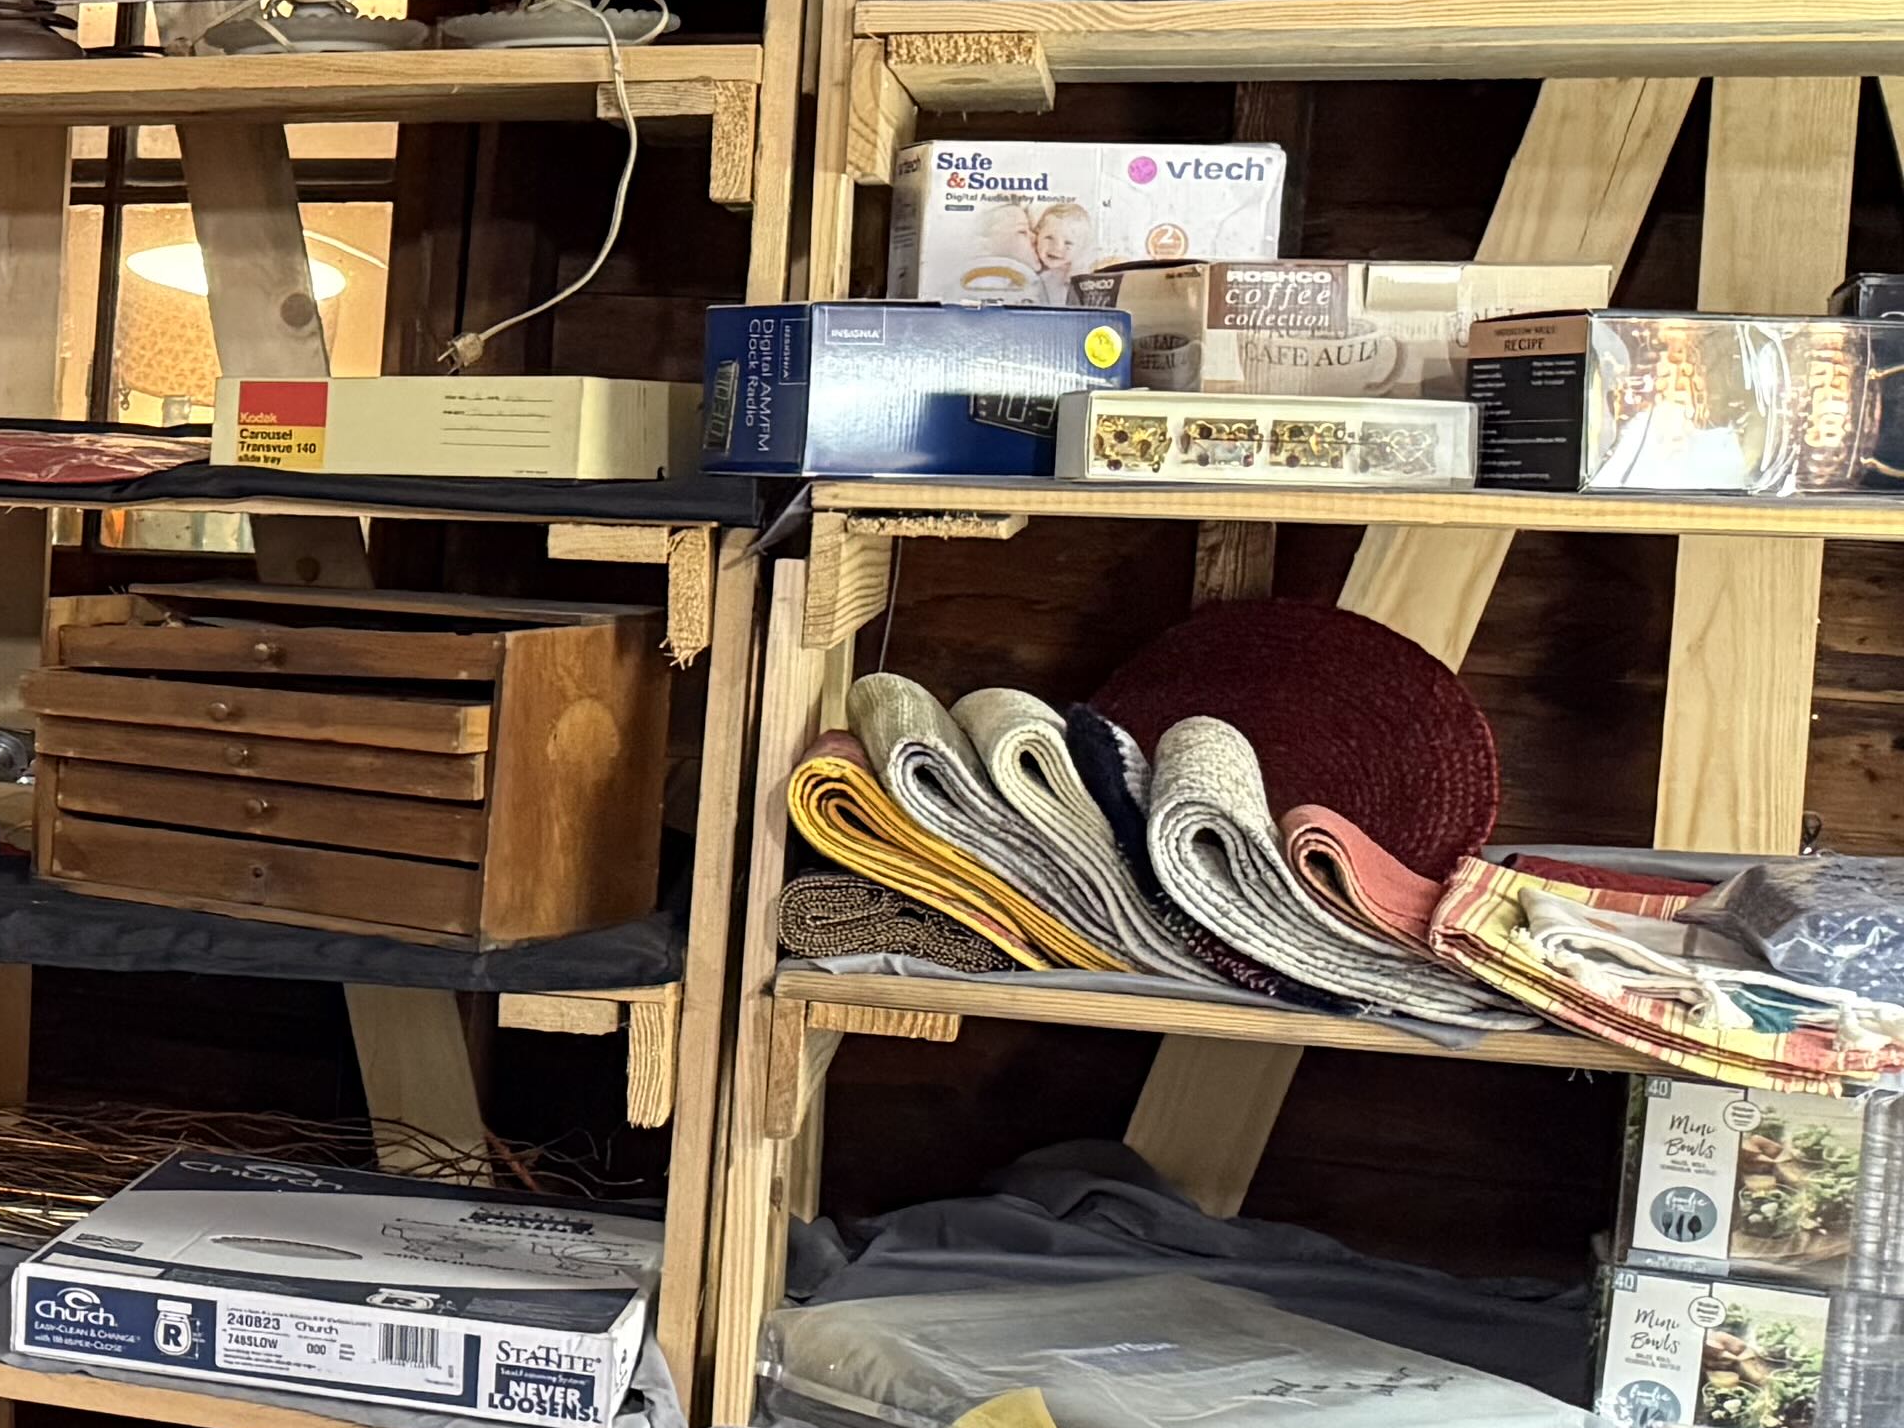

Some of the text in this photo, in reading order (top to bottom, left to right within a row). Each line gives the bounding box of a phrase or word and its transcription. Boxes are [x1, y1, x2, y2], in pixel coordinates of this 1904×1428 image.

[937, 152, 992, 170] Safe
[1167, 157, 1265, 181] vtech
[946, 193, 978, 204] Digital
[1159, 226, 1175, 244] 2
[1226, 270, 1332, 285] ROSHCO
[1225, 283, 1331, 311] coffee
[1224, 309, 1330, 328] collection
[1504, 338, 1545, 352] RECIPE
[1314, 343, 1352, 368] AU
[746, 319, 761, 427] Clock Radio
[758, 319, 774, 452] Digital AM/FM
[239, 412, 278, 423] Kodak
[239, 428, 293, 440] Carousel
[239, 441, 316, 454] Transvue 140
[238, 454, 281, 466] slide tray
[1648, 1080, 1668, 1097] 40
[1664, 1137, 1716, 1160] Bowls
[179, 1159, 343, 1190] Church
[1614, 1273, 1635, 1291] 40
[35, 1300, 115, 1328] Church
[162, 1323, 182, 1348] R
[295, 1321, 339, 1335] Church
[1631, 1331, 1680, 1354] Bowls
[509, 1380, 580, 1407] NEVER
[488, 1393, 603, 1423] LOOSENS!
